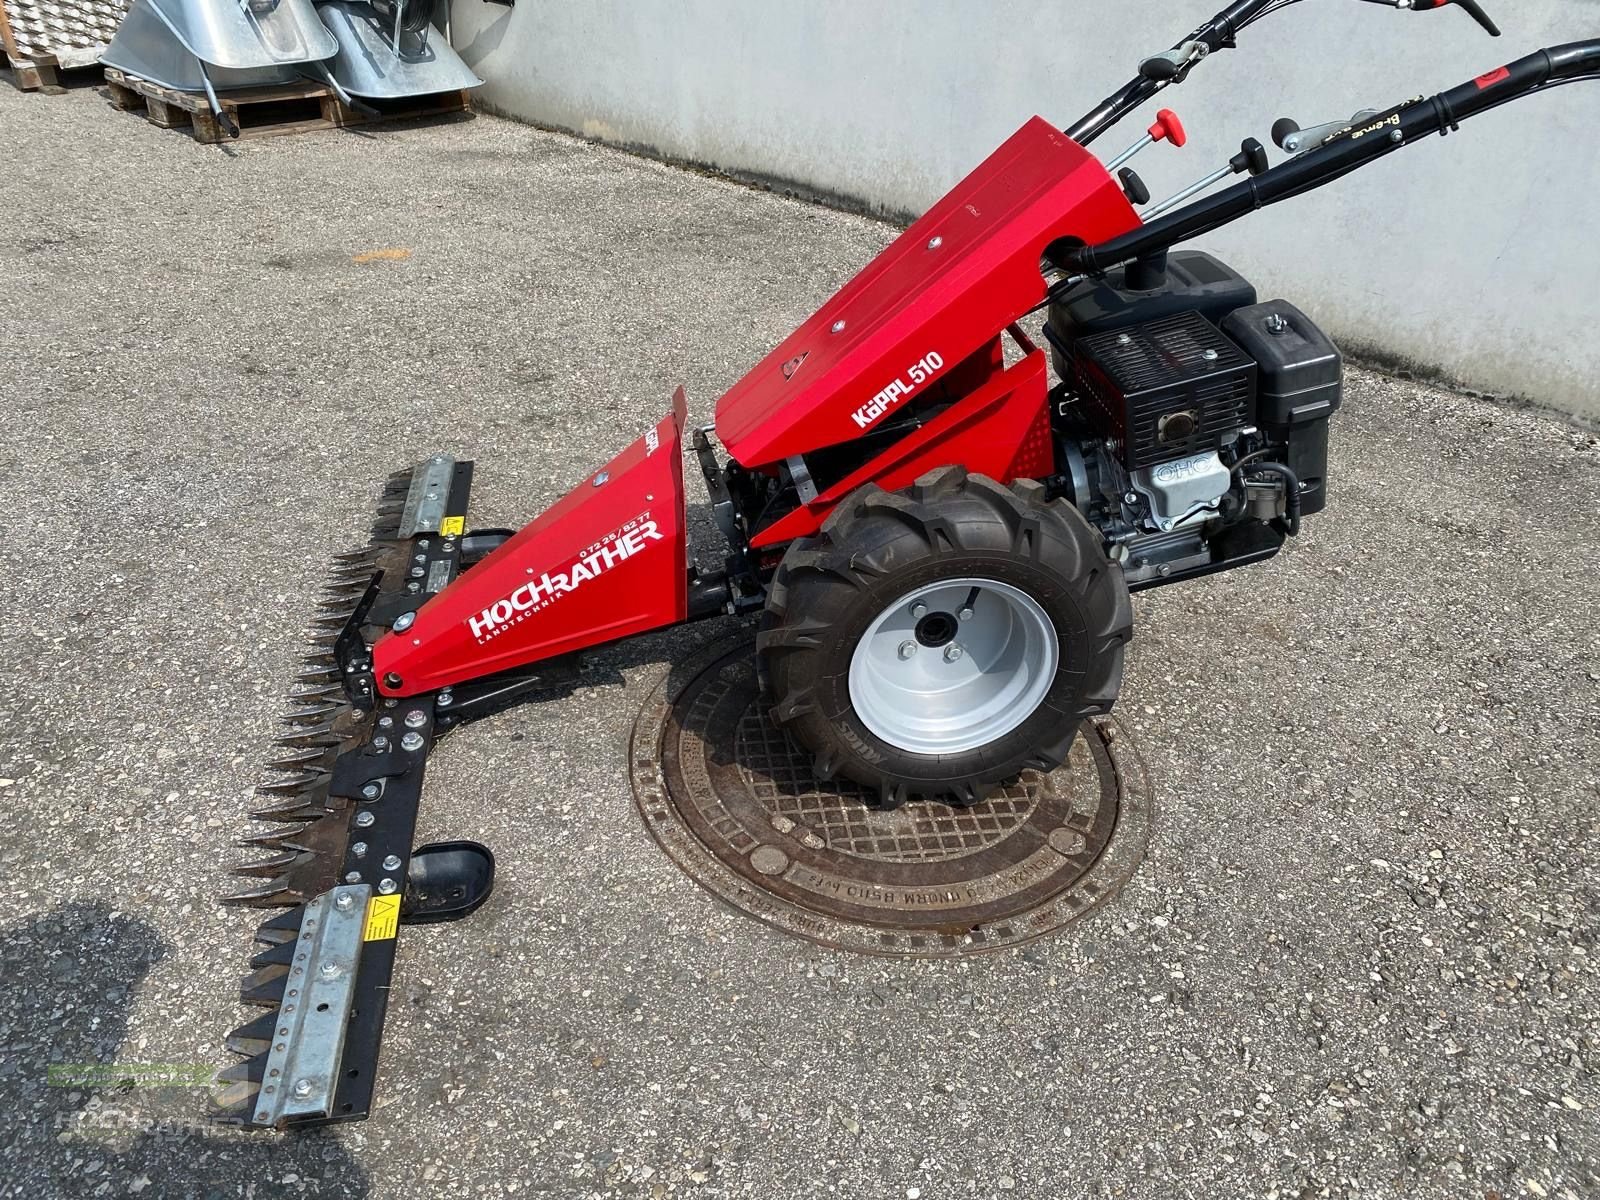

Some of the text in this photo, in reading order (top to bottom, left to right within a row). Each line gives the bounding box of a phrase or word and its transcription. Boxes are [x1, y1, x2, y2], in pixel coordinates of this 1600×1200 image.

[1351, 113, 1400, 139] Bremse
[907, 351, 944, 384] 510
[1157, 456, 1210, 481] OHC
[468, 520, 664, 638] HOCHRATHER
[478, 591, 564, 645] LANDTECHNIK
